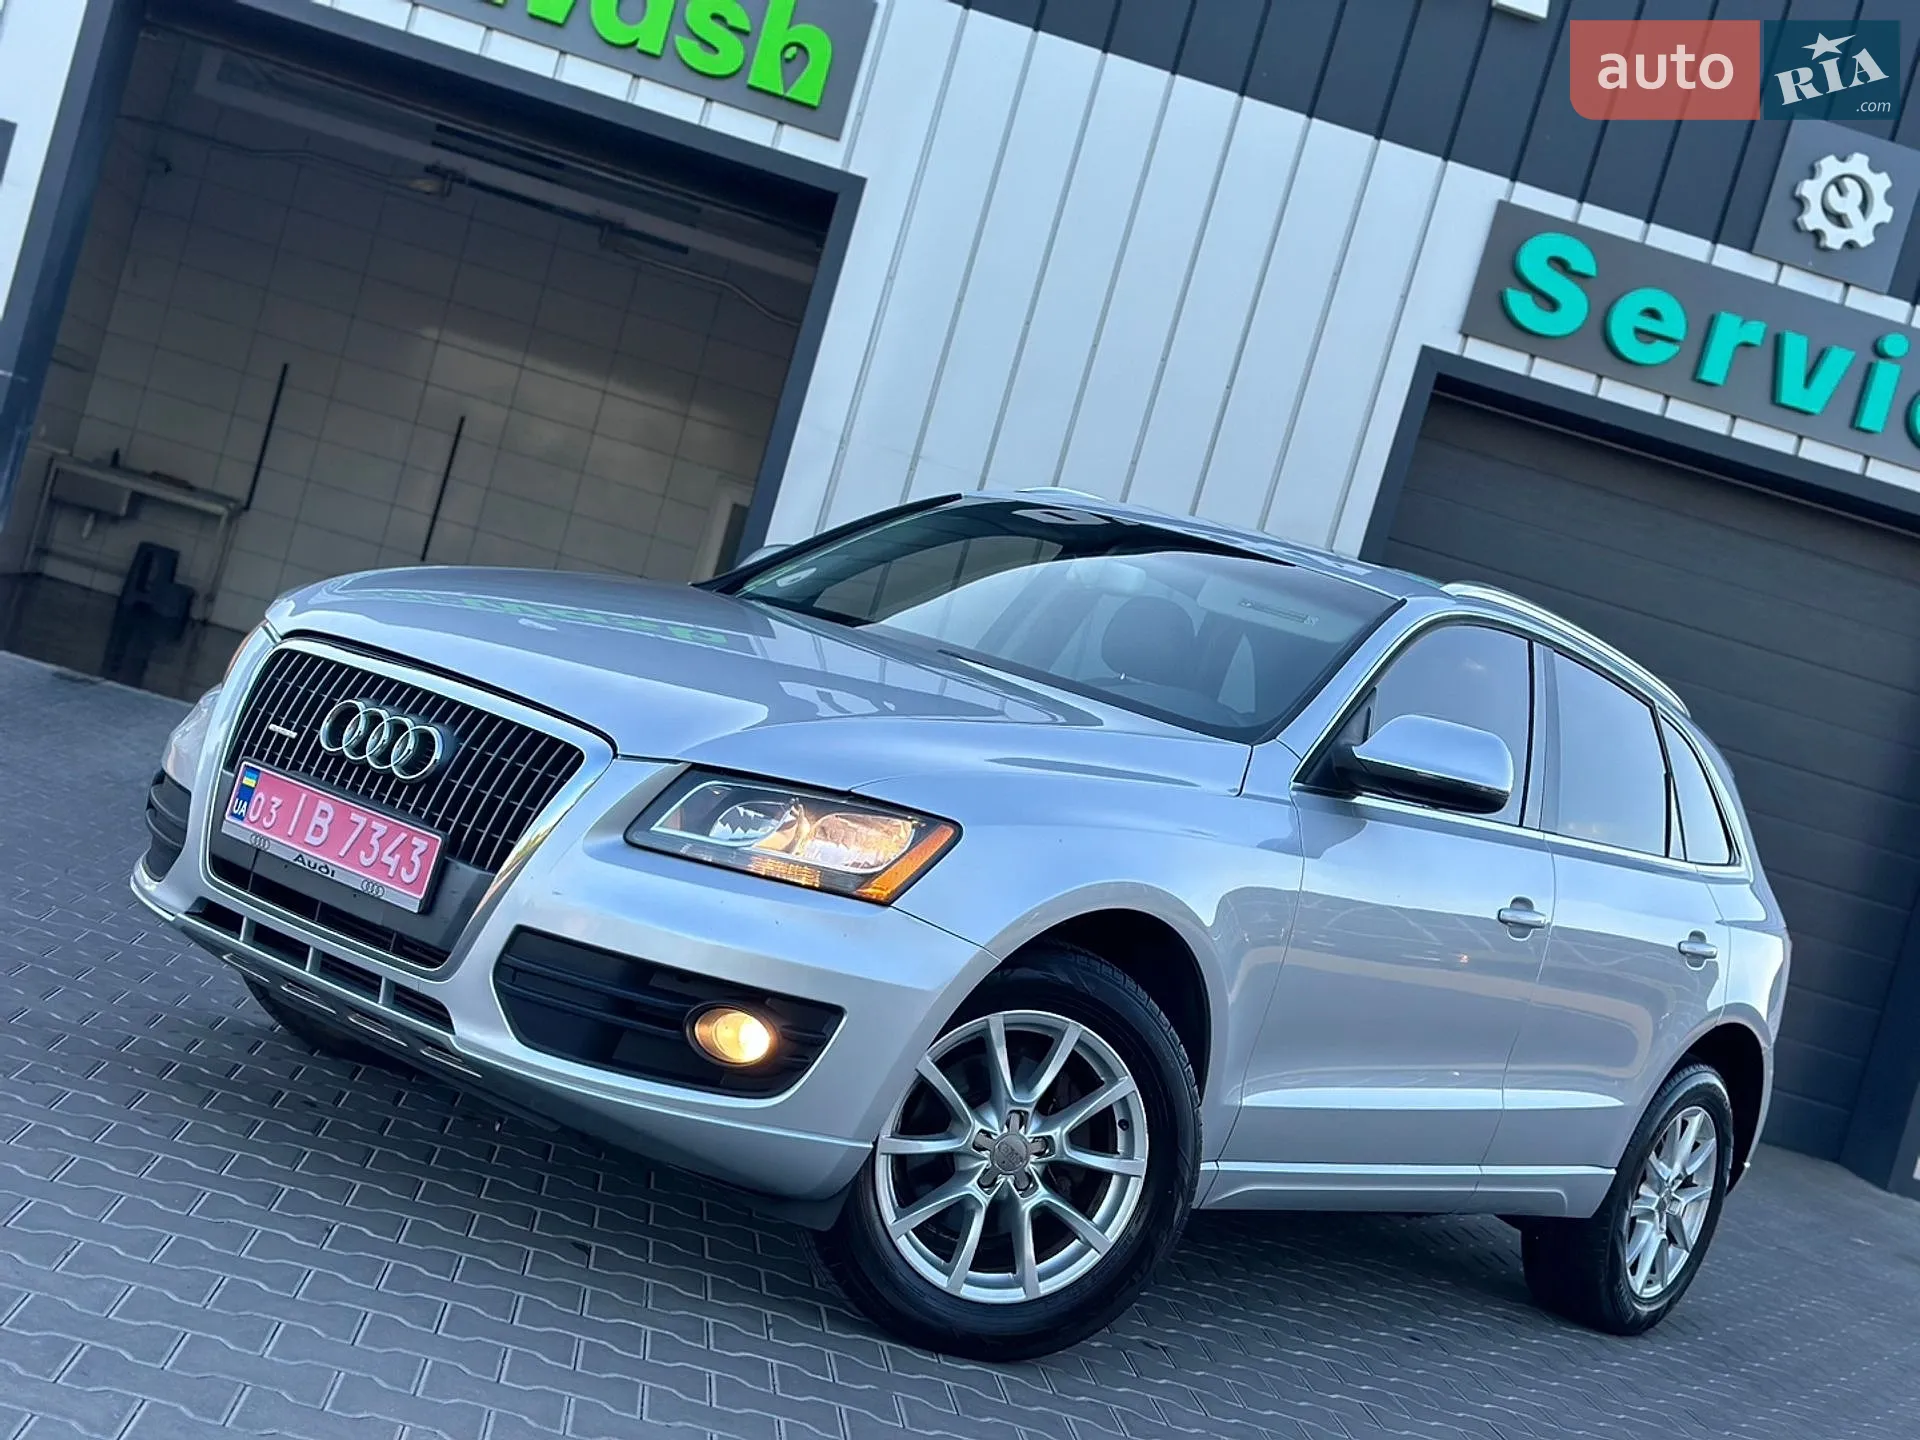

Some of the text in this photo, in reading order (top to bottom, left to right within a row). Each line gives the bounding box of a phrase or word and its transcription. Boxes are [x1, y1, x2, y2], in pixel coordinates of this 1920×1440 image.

[478, 0, 832, 108] ash
[1502, 231, 1920, 448] Servi
[233, 798, 248, 817] UA
[249, 792, 283, 828] 03
[339, 814, 428, 884] 7343
[293, 854, 336, 877] Audi
